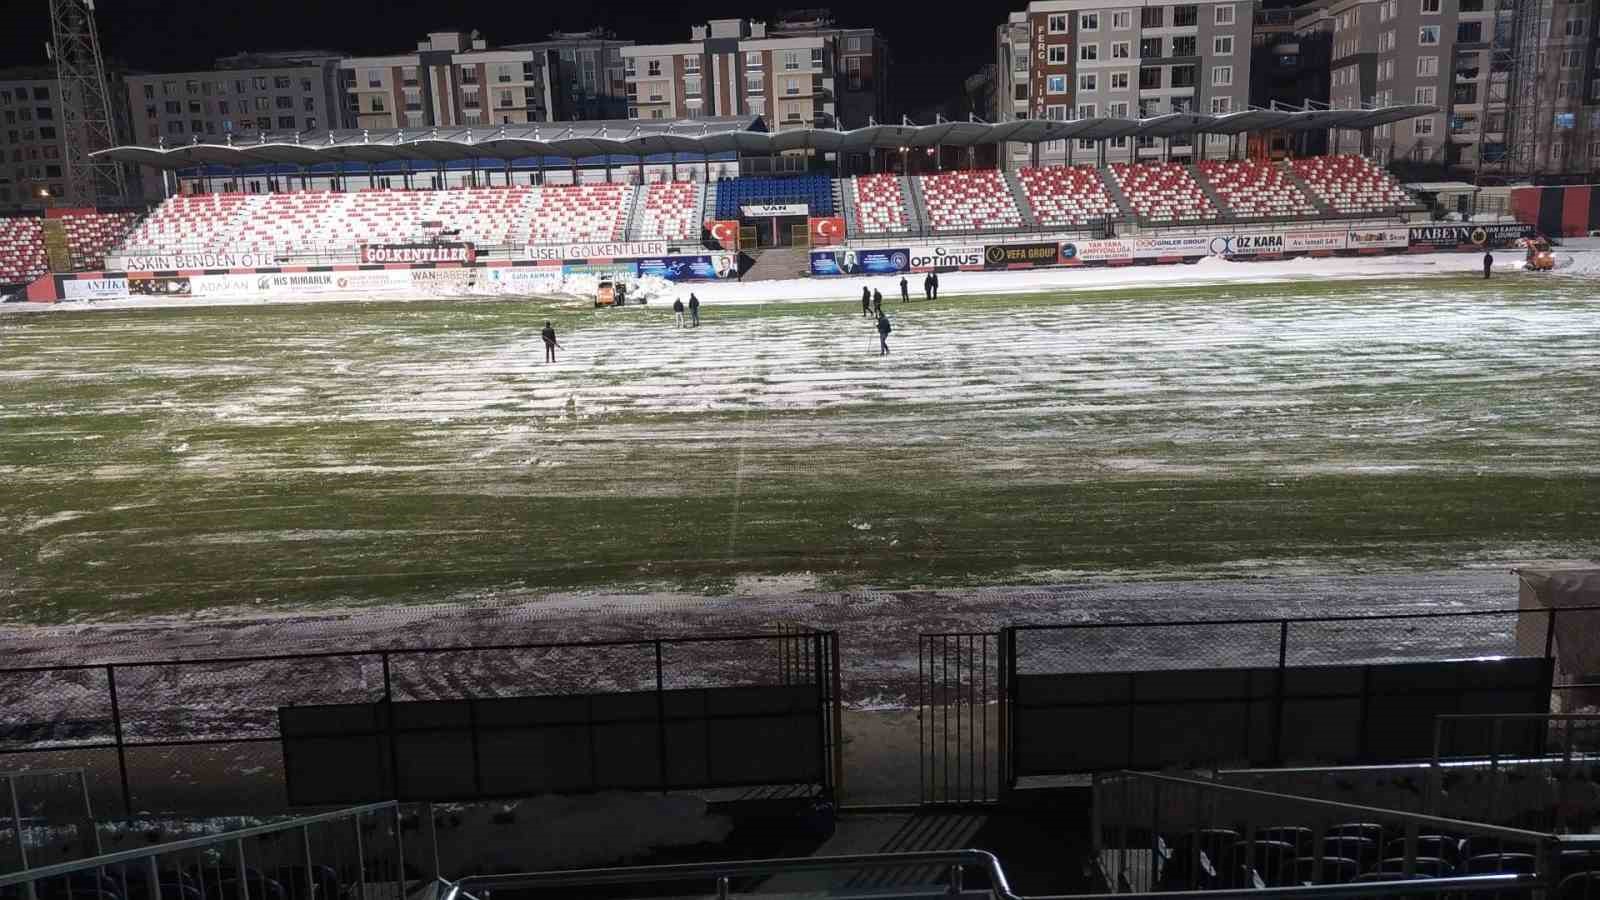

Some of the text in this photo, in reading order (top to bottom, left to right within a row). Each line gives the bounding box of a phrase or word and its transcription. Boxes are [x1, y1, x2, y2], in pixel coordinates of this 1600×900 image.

[1409, 227, 1470, 240] MABEYN
[1237, 235, 1250, 248] ÖZ
[1254, 235, 1282, 247] KARA
[367, 245, 466, 262] GÖLKENTLİLER
[1028, 248, 1056, 257] GROUP
[175, 254, 236, 269] BENDEN
